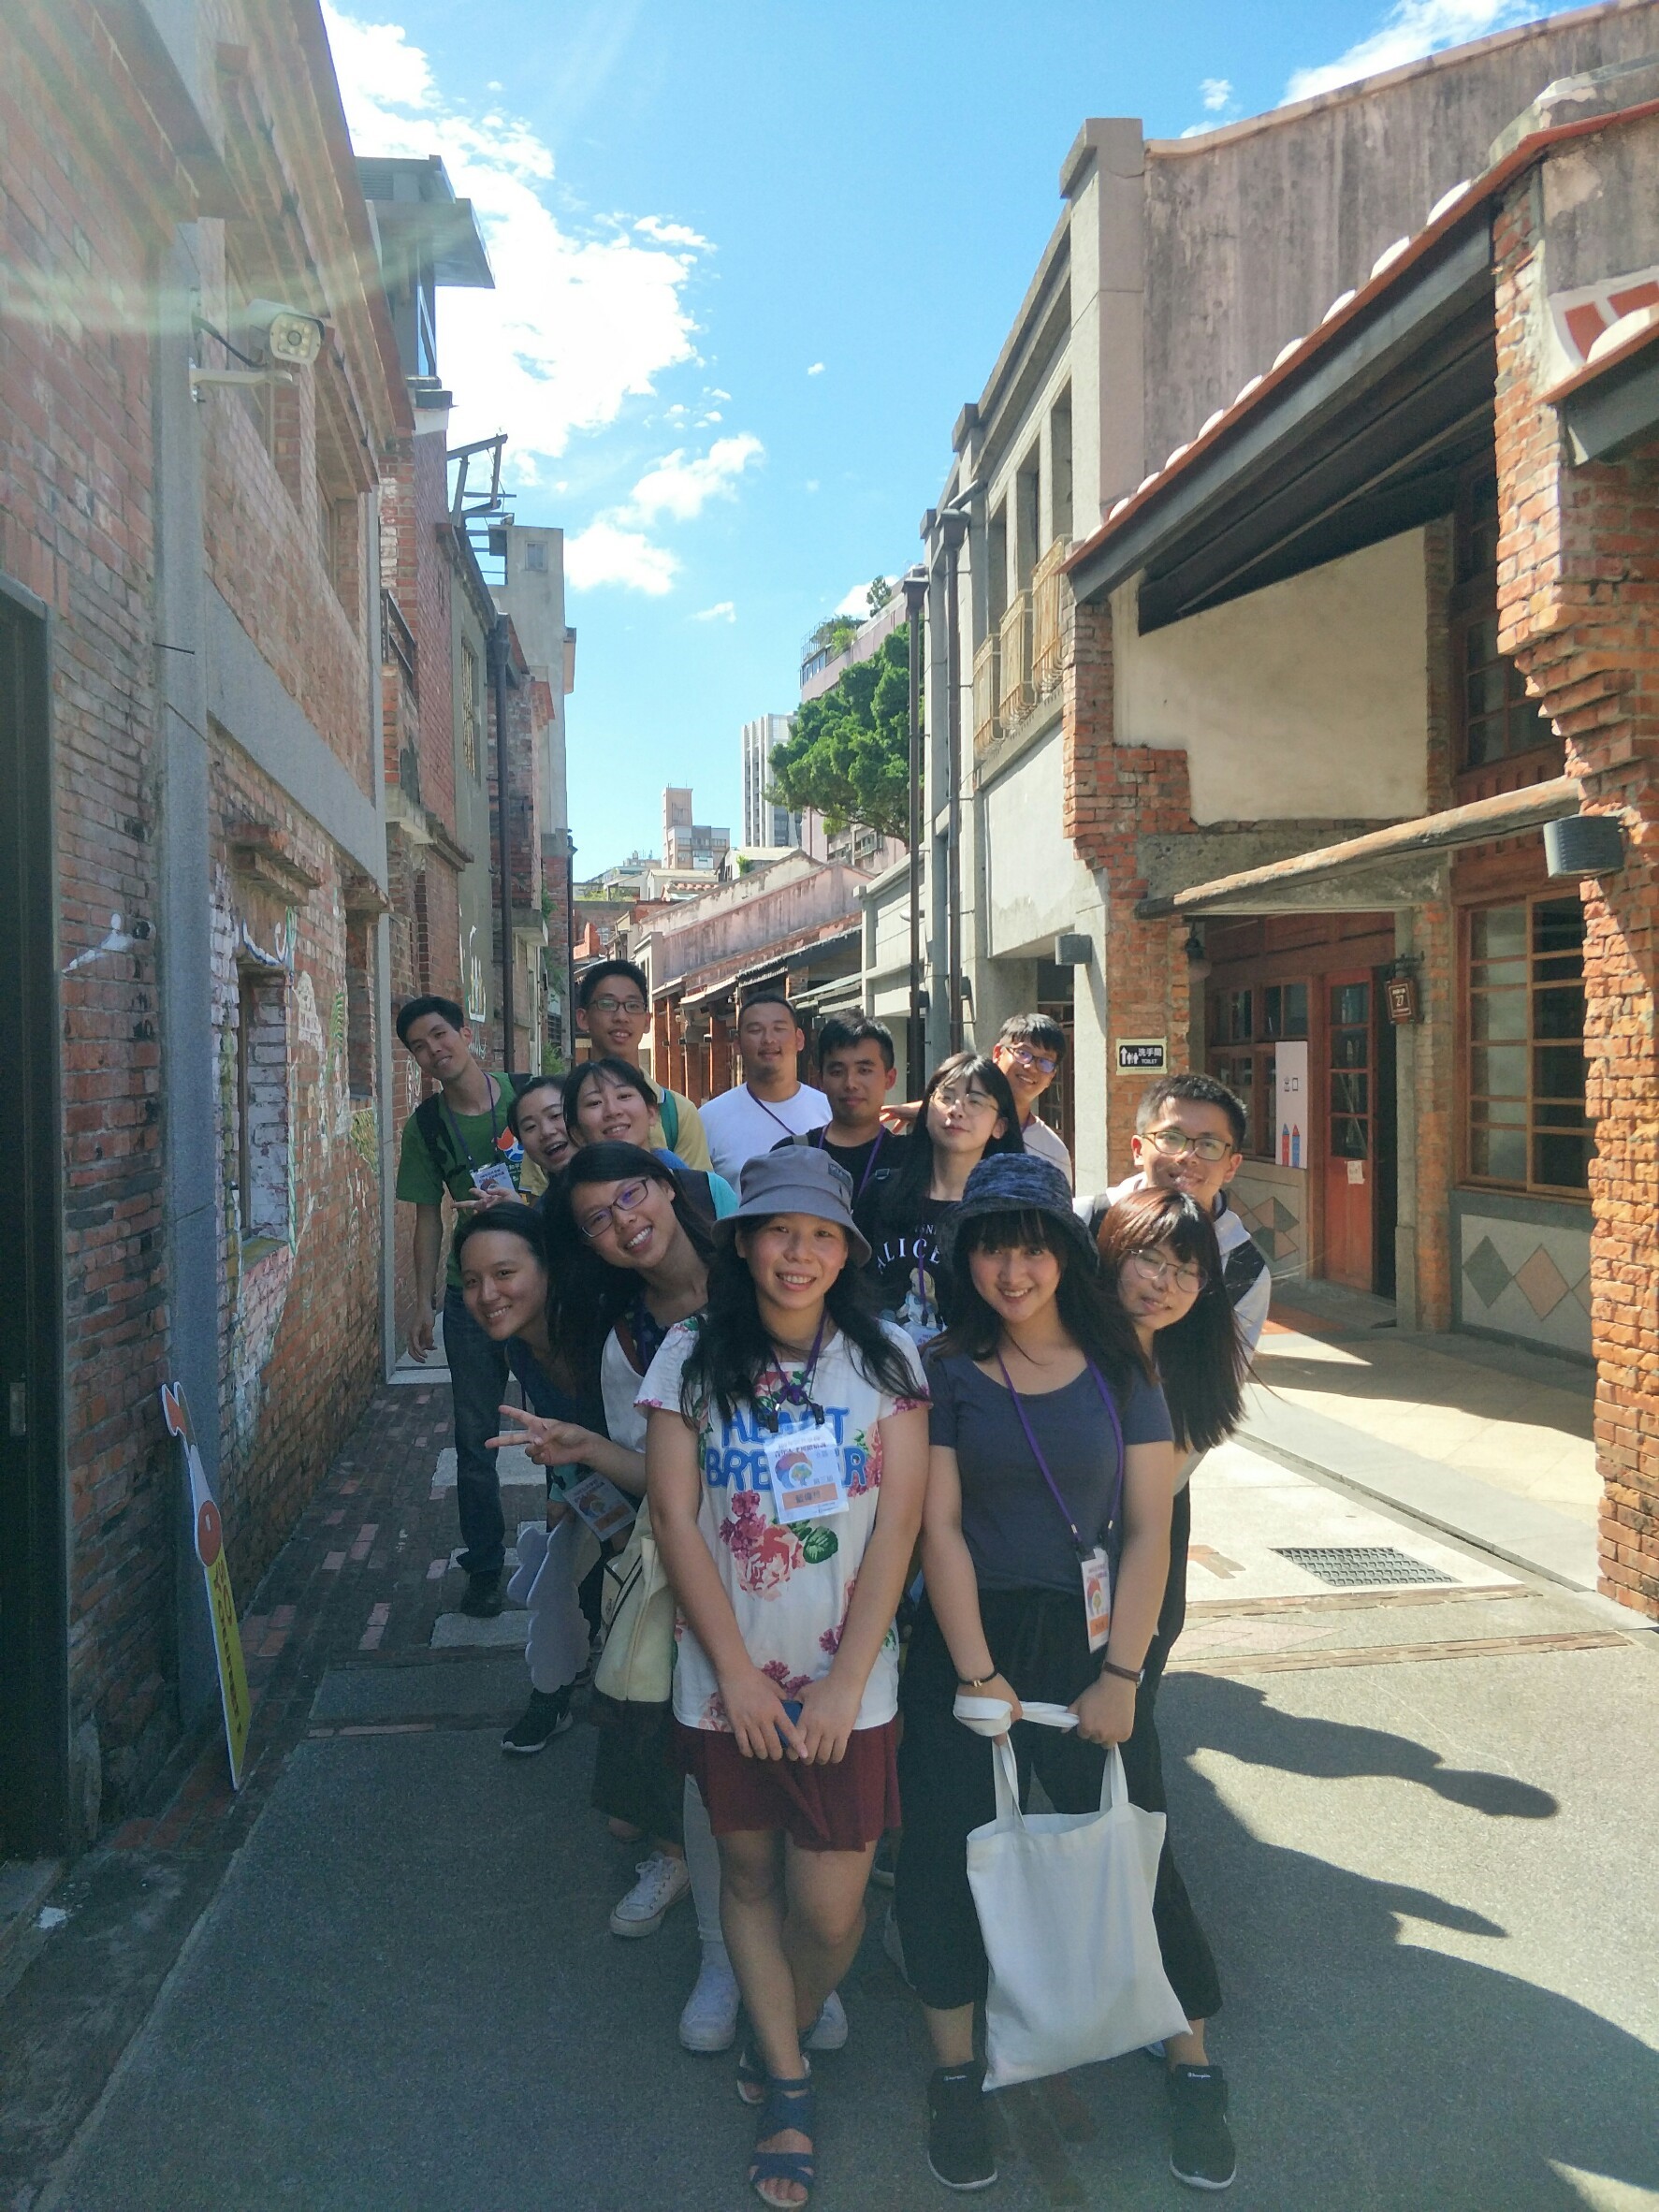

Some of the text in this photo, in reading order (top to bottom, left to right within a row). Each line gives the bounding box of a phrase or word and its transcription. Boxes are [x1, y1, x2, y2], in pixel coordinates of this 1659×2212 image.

[1138, 1047, 1162, 1057] 洗手間
[877, 1237, 940, 1275] ALICE
